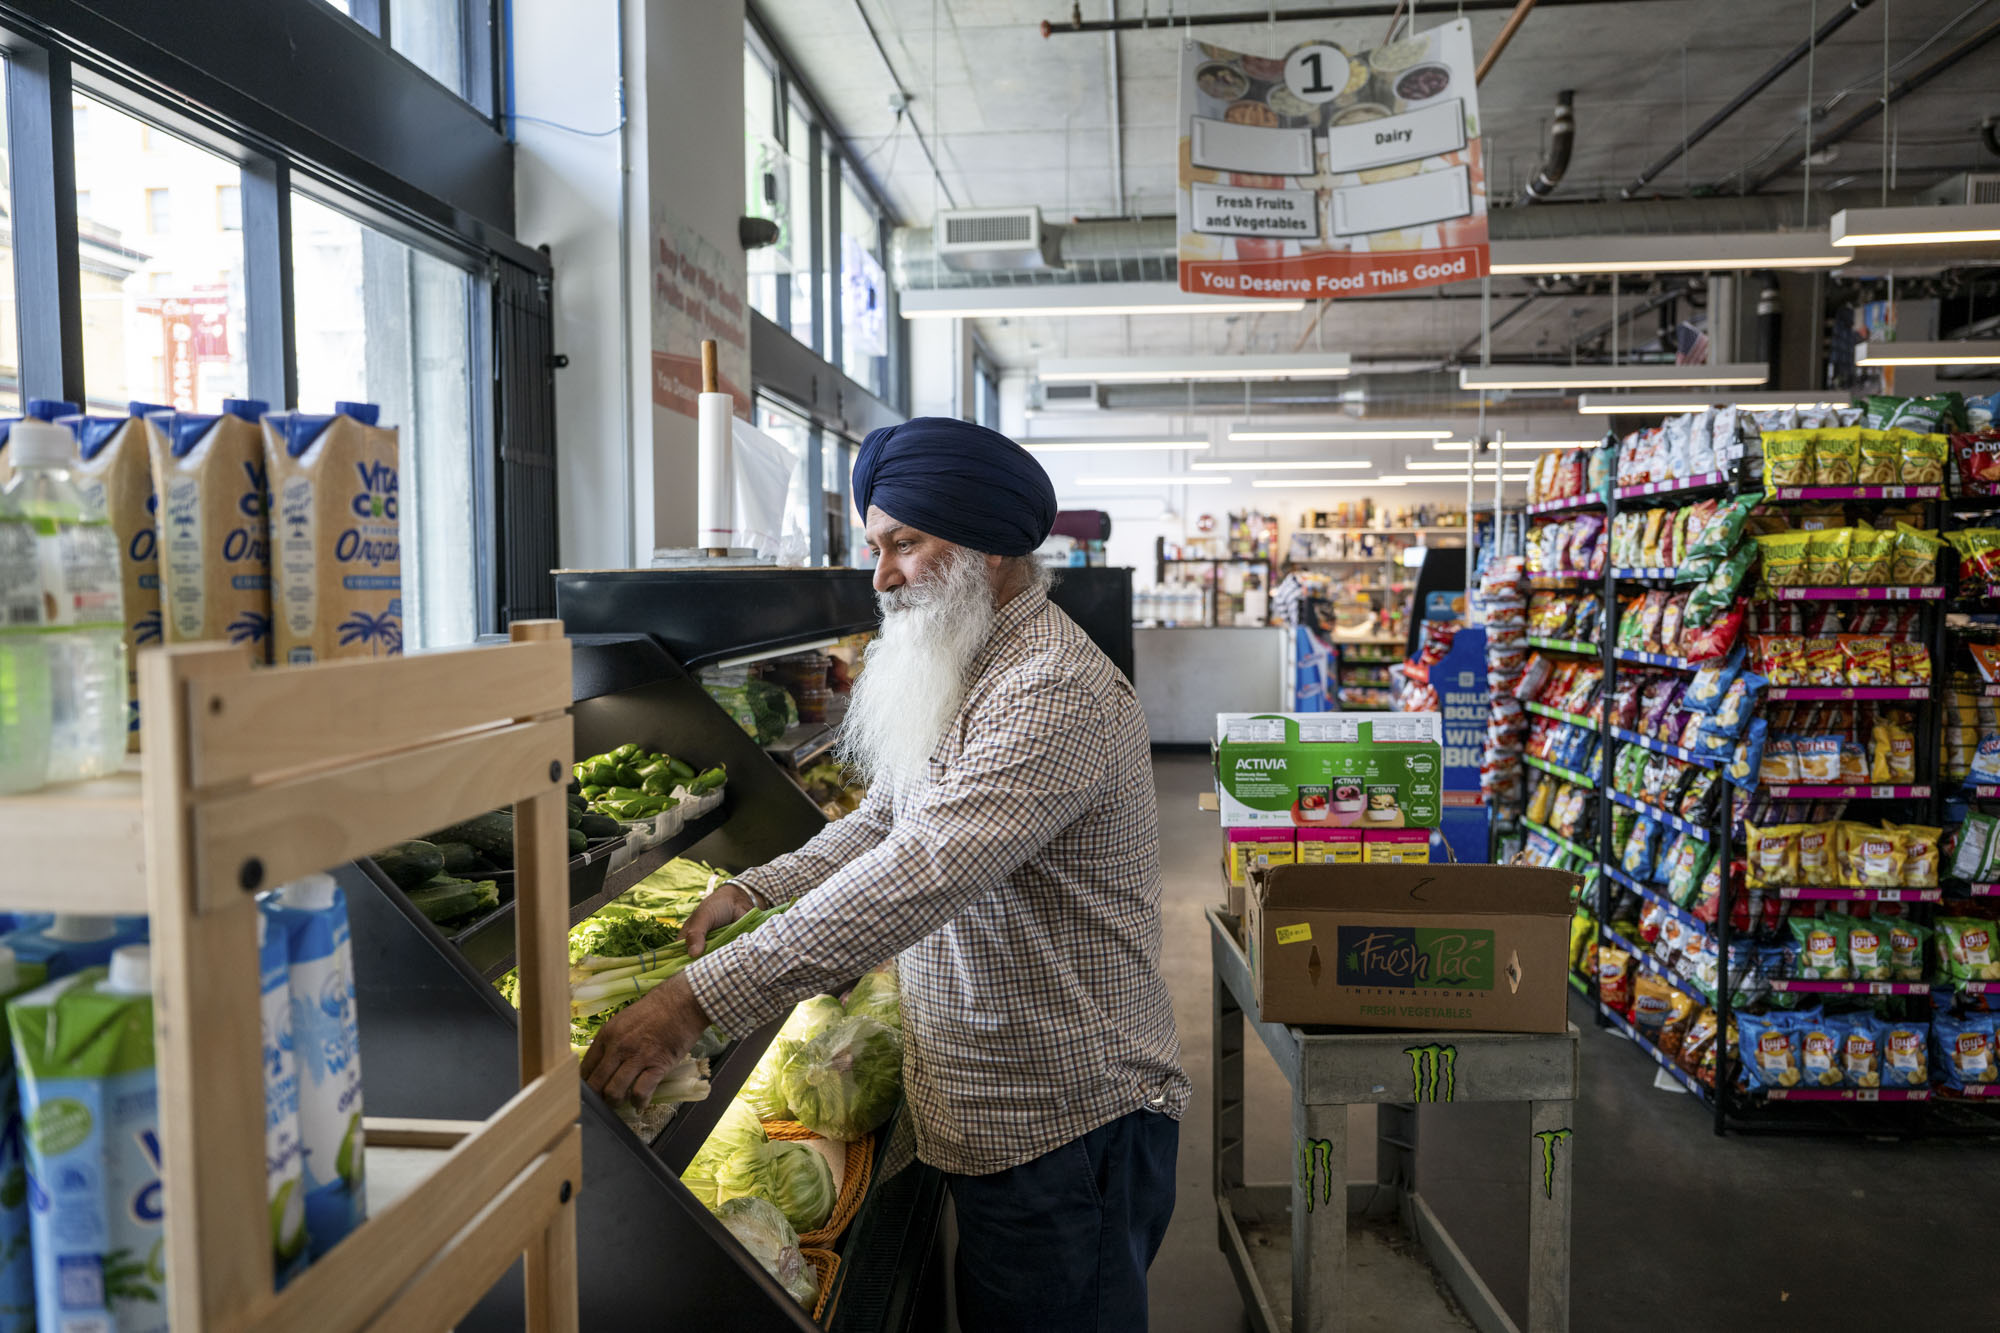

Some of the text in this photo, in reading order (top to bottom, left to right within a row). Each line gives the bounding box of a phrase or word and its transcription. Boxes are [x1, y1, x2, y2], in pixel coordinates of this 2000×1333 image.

[1300, 53, 1333, 94] 1
[1375, 128, 1412, 145] Dairy
[1216, 195, 1294, 211] Fresh Fruits
[1206, 216, 1307, 233] and Vegetables
[1201, 257, 1466, 292] You Deserve Food This Good
[1445, 692, 1489, 705] BUILD
[1235, 758, 1287, 770] ACTIVIA
[1406, 757, 1414, 769] 3
[1352, 932, 1482, 980] Fresh Pac
[1345, 988, 1486, 998] INTERNATIONAL
[1359, 1005, 1472, 1019] FRESH VEGETABLES
